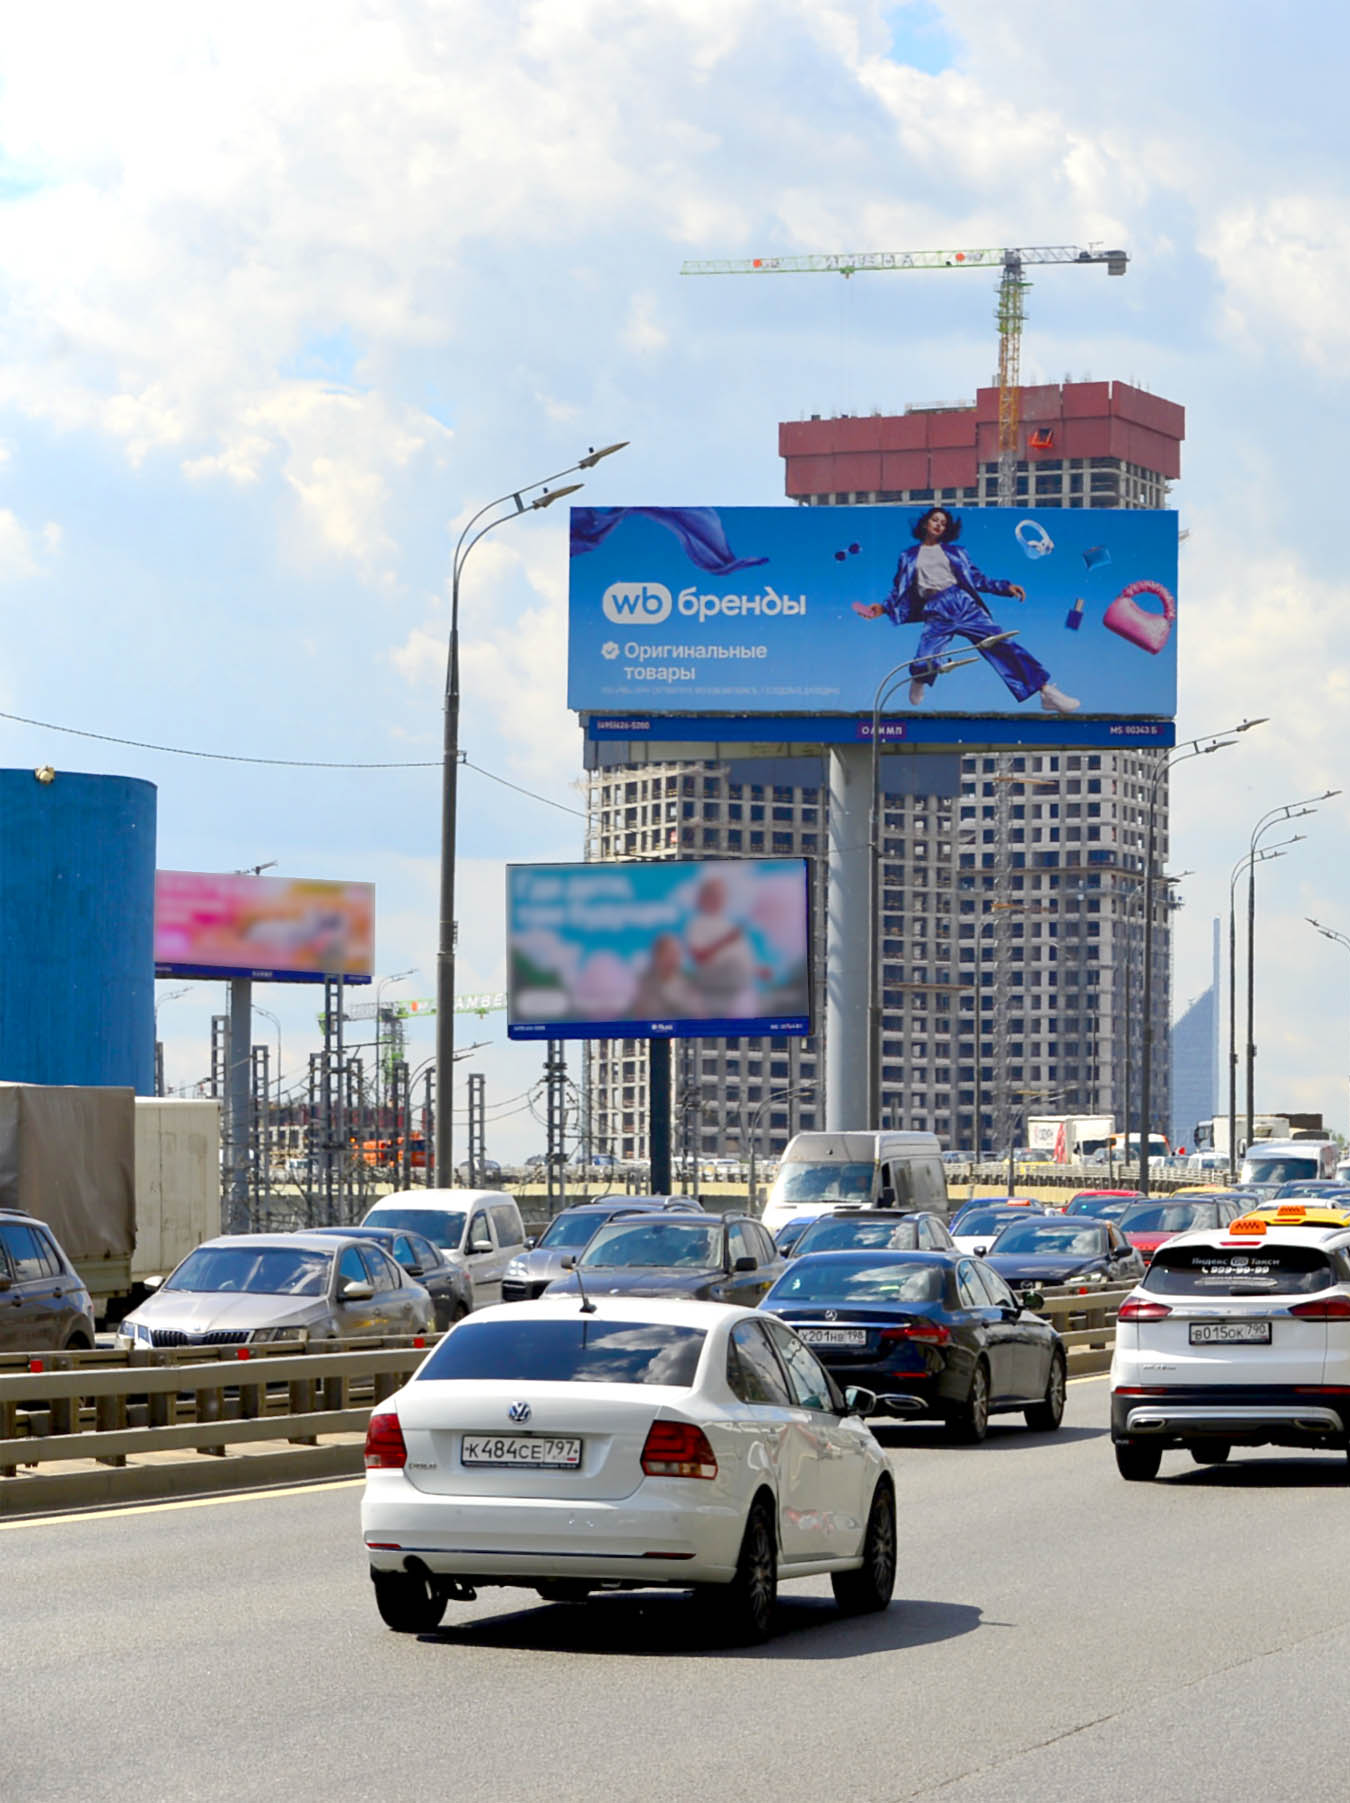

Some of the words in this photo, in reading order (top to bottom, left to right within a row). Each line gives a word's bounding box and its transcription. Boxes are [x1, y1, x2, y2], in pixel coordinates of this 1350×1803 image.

[611, 587, 663, 618] wb
[678, 586, 807, 623] бренды
[624, 641, 768, 664] Оригинальные
[625, 665, 696, 683] товары
[1250, 1257, 1280, 1266] Такси
